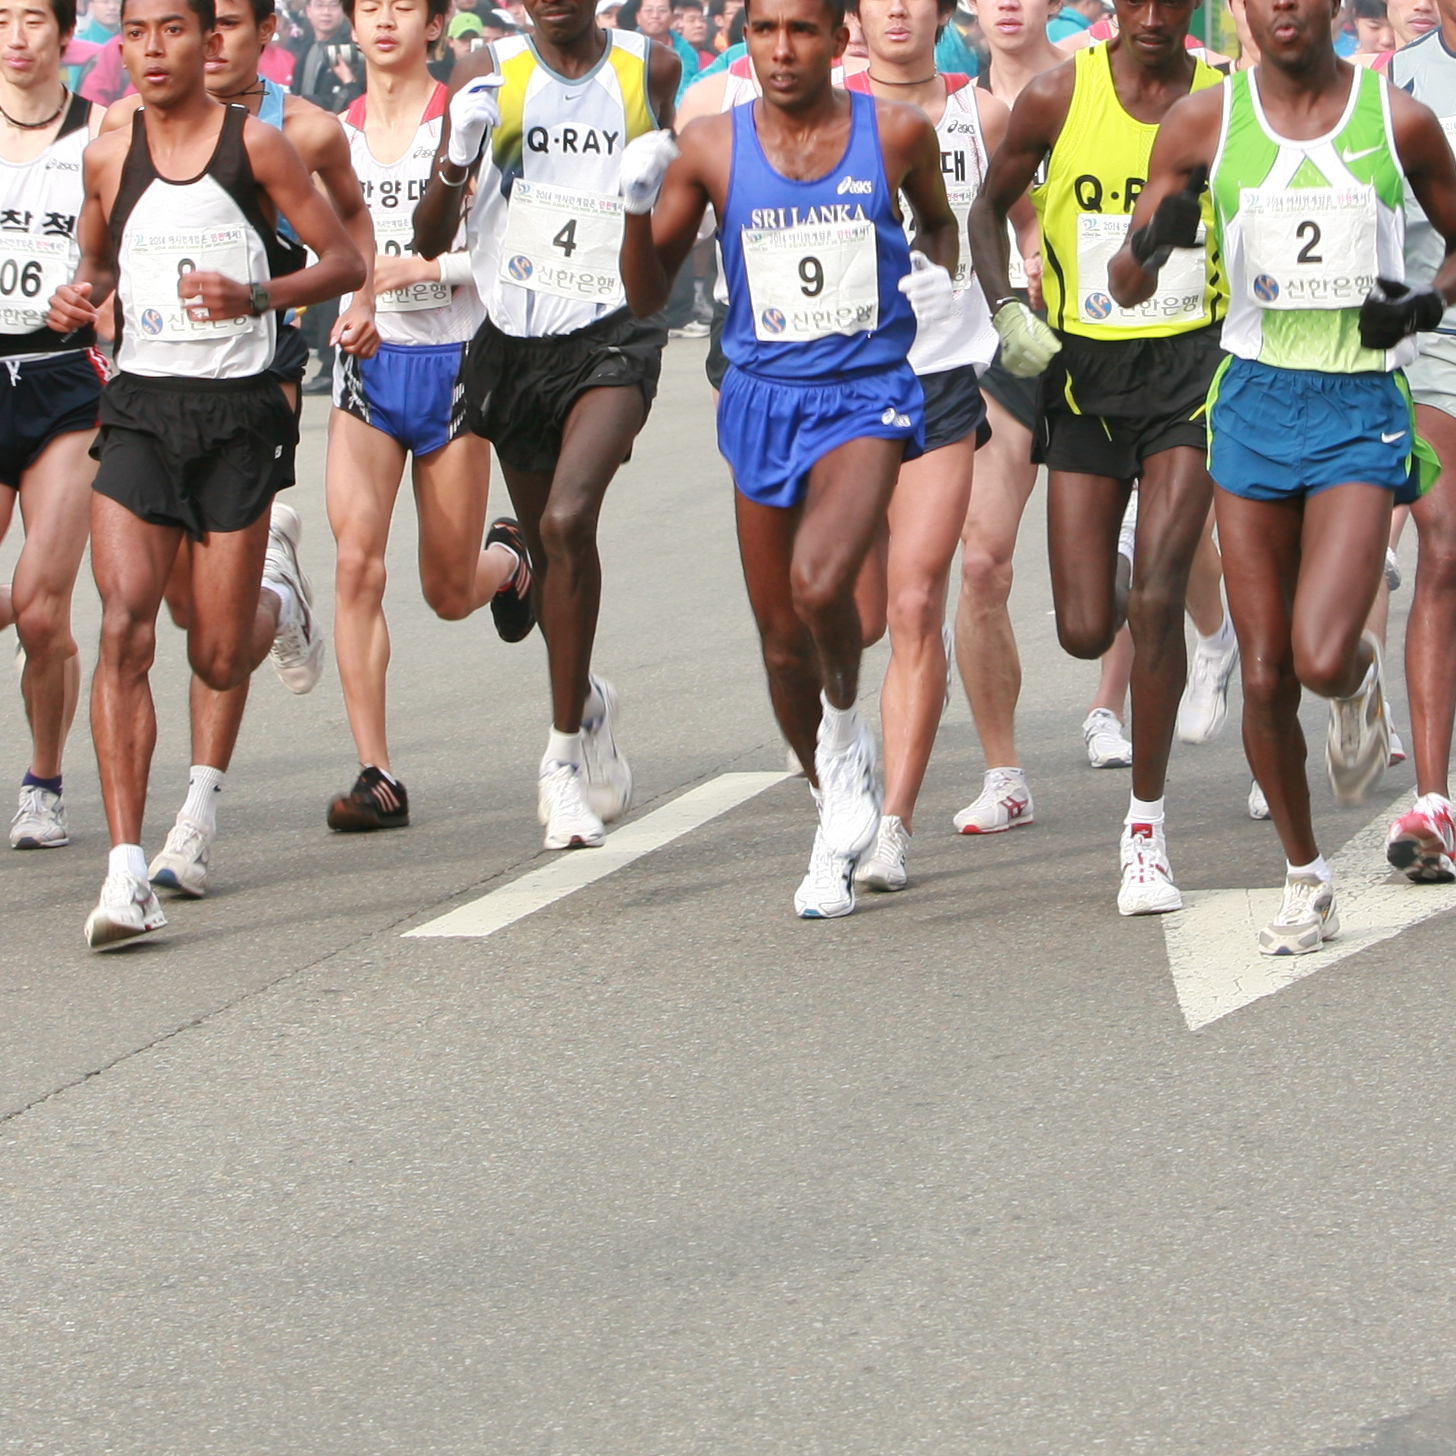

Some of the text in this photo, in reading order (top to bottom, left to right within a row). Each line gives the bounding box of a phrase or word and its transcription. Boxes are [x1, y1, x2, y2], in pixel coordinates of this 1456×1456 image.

[751, 203, 867, 230] SRI LANKA
[552, 218, 578, 258] 4
[1296, 220, 1323, 264] 2
[537, 263, 616, 295] 신한은행
[797, 255, 825, 297] 9
[1287, 274, 1374, 300] 신한은행
[791, 303, 873, 332] 신한은행
